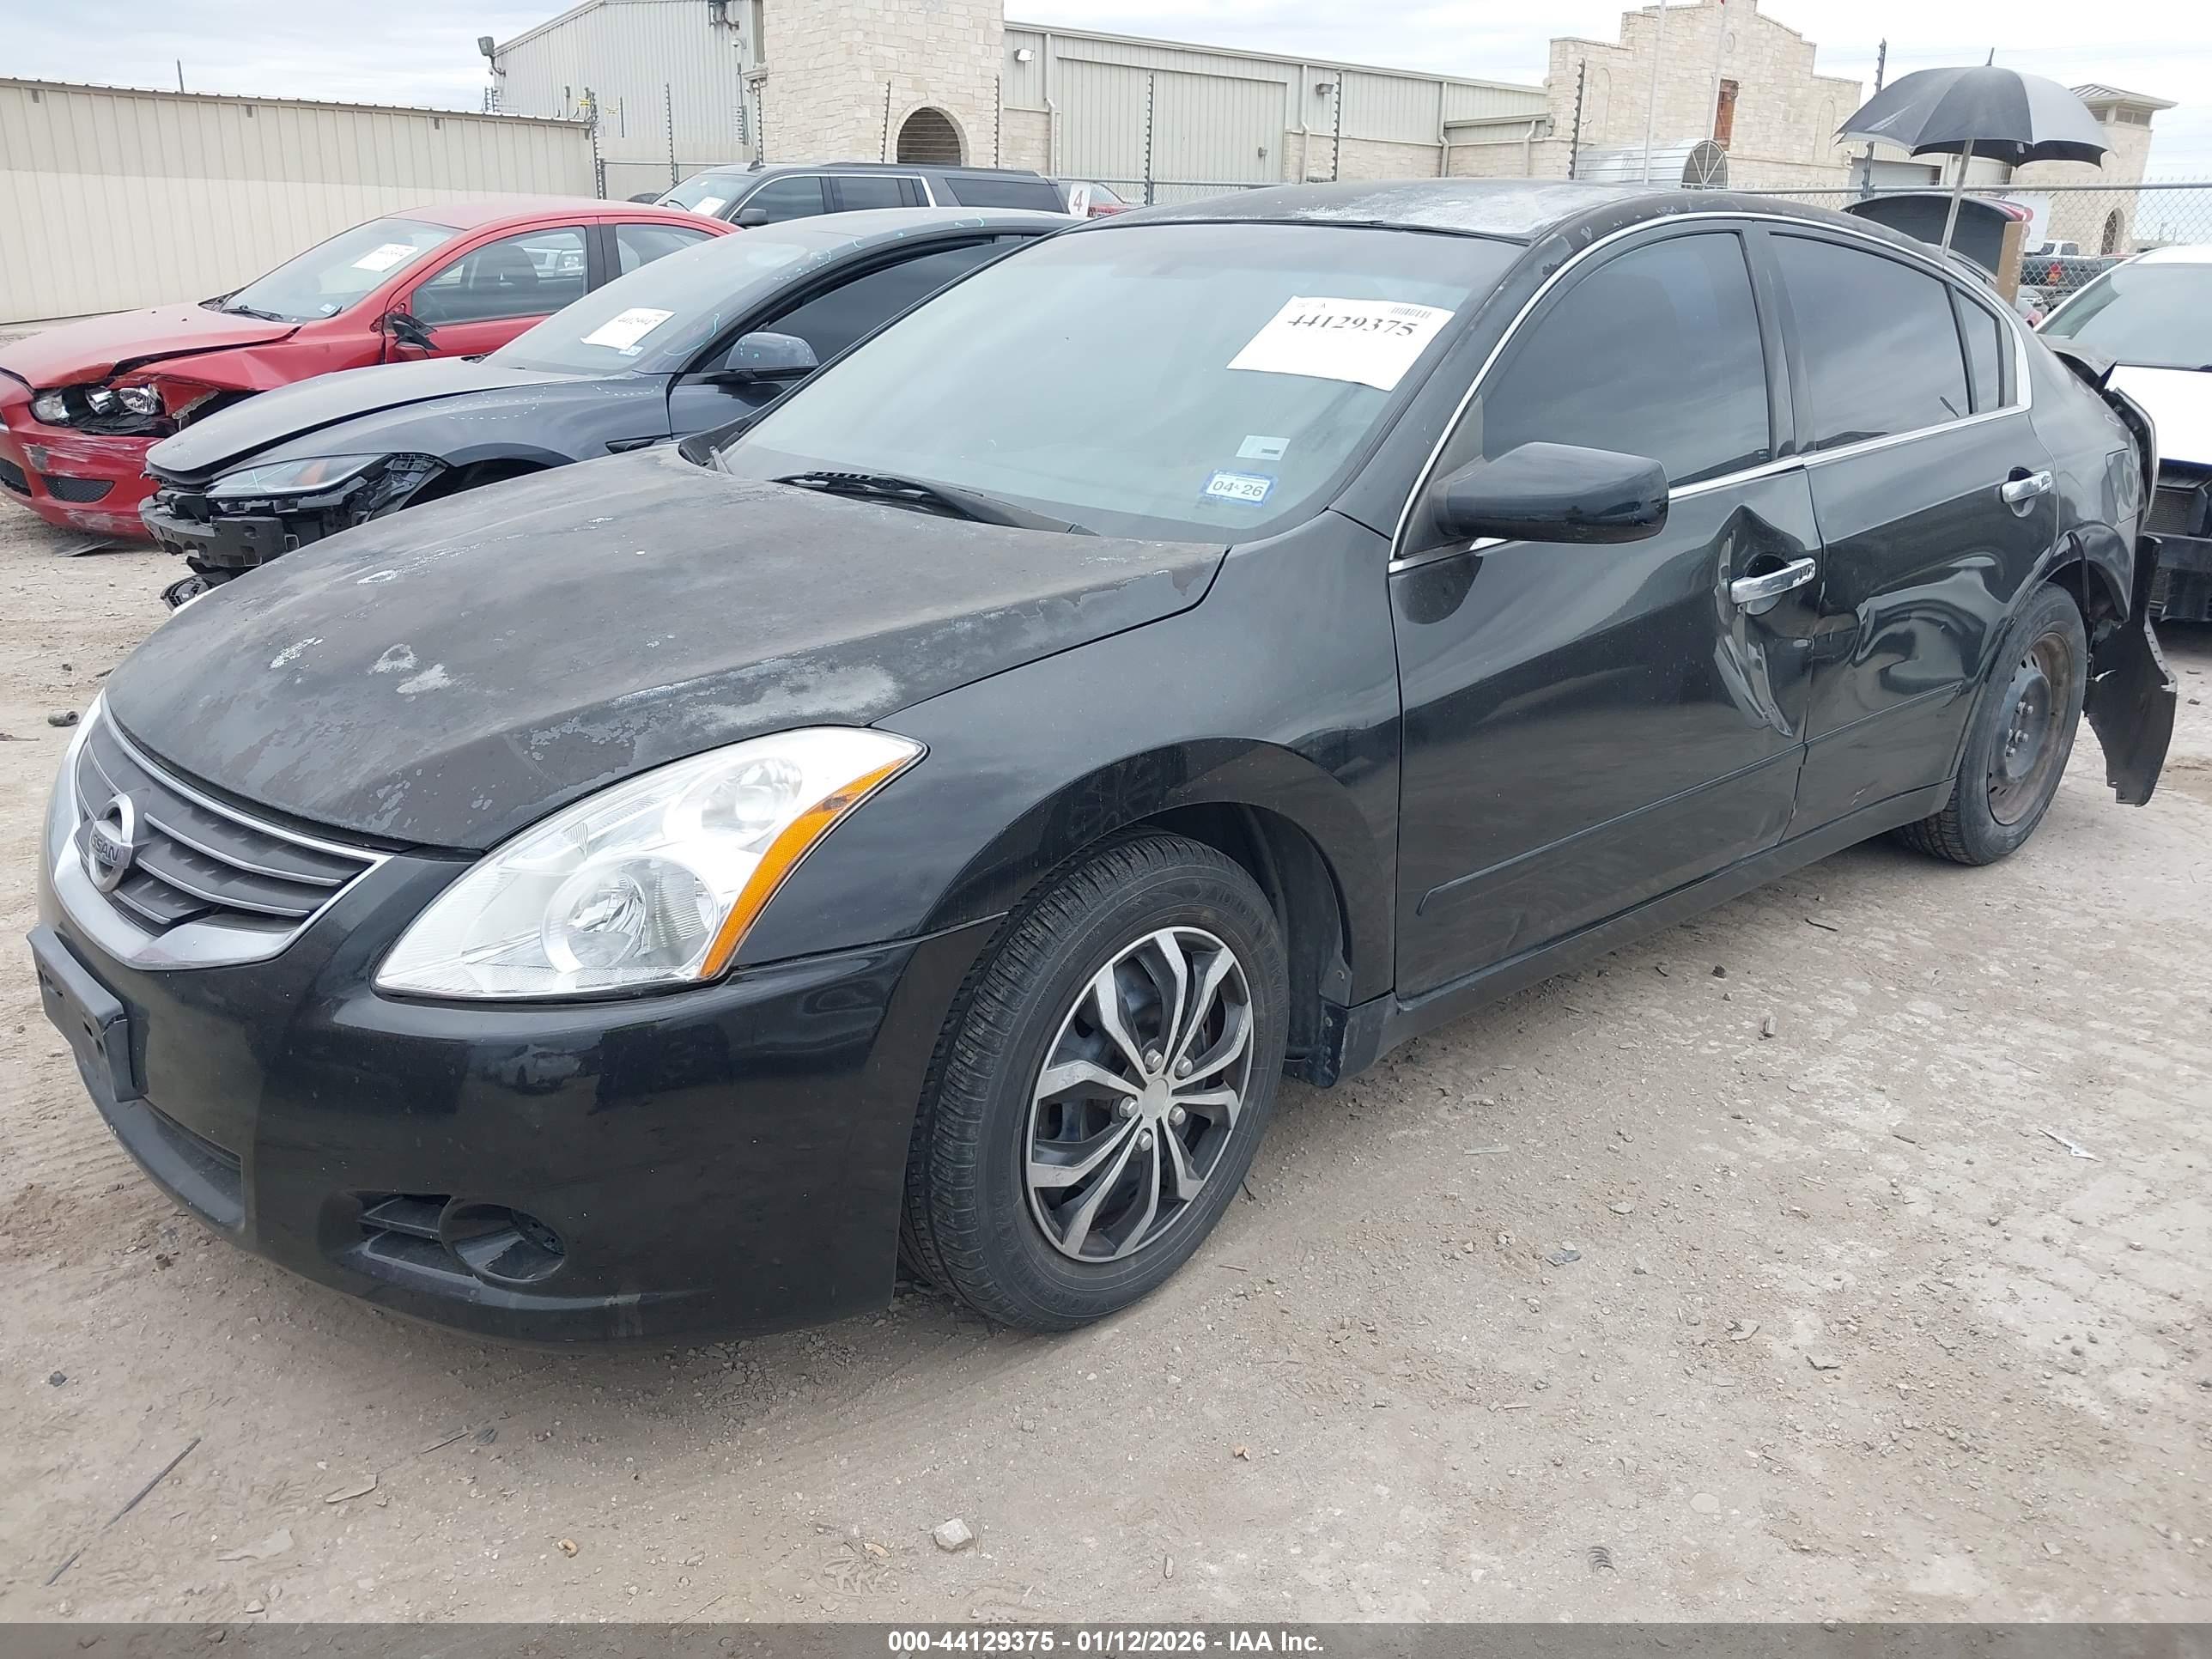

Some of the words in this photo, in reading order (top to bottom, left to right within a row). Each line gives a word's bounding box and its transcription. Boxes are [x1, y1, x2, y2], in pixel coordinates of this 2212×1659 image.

[1073, 190, 1084, 212] 4
[1287, 314, 1418, 336] 44129375
[1212, 480, 1234, 492] 04
[1241, 484, 1264, 496] 26
